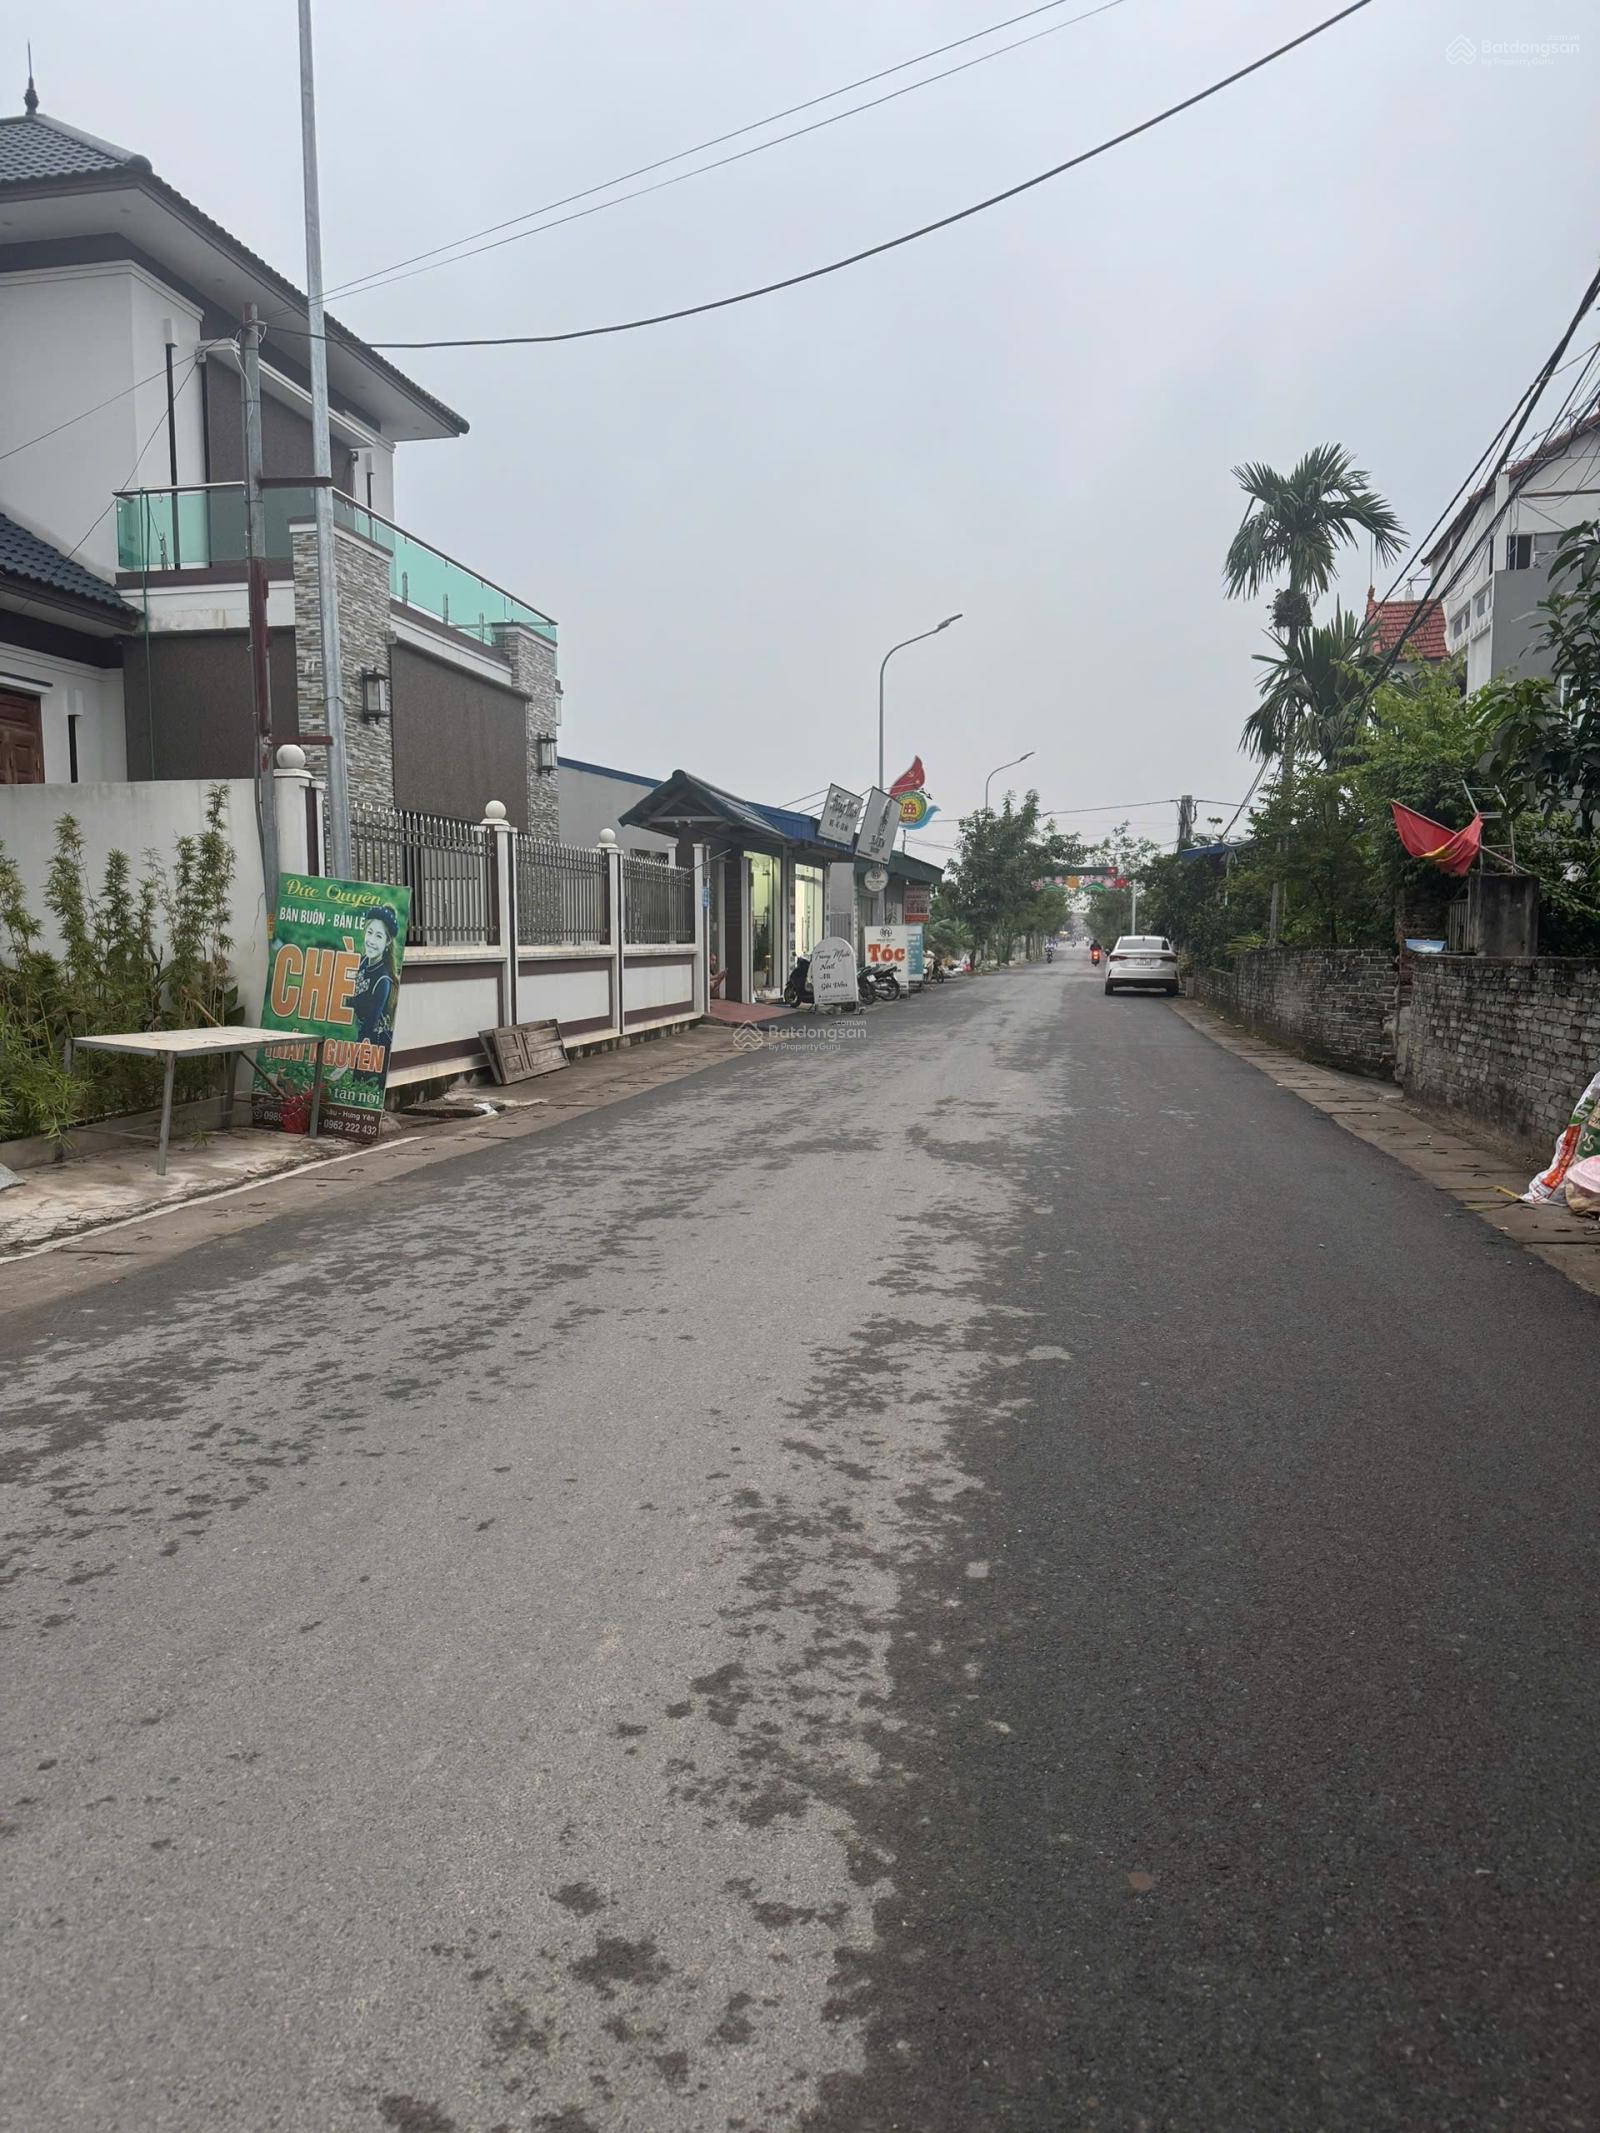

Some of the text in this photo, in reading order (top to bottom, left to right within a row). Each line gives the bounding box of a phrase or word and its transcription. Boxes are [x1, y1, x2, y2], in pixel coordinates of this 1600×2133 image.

[287, 878, 383, 908] Đức Quyên
[279, 905, 299, 923] BÁN
[333, 911, 353, 930] BÁN
[271, 936, 361, 1025] CHÈ
[323, 1119, 344, 1130] 0962
[344, 1122, 361, 1134] 222
[361, 1125, 378, 1136] 432
